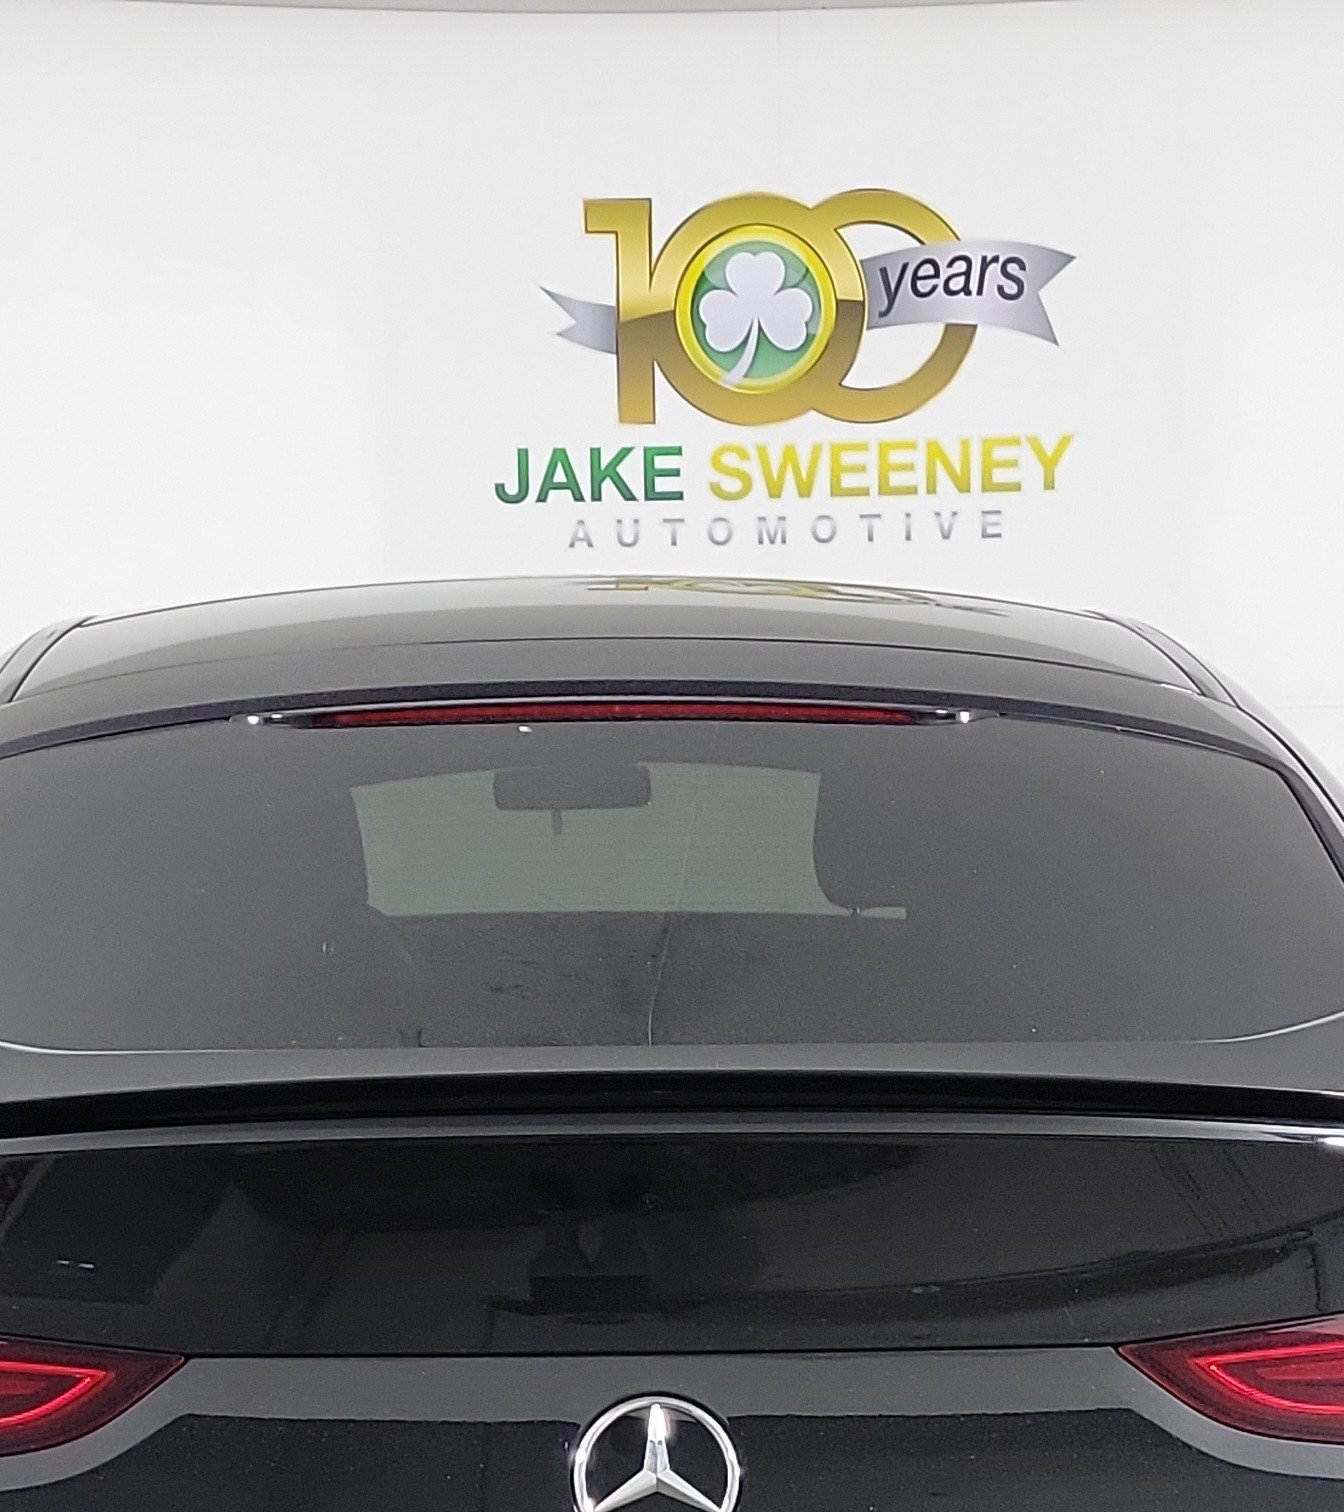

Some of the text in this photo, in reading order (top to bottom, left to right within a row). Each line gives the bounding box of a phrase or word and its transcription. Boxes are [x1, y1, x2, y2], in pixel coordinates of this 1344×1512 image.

[583, 187, 1028, 428] 100 years
[494, 434, 1074, 505] JAKE SWEENEY
[568, 510, 1004, 549] AUTOMOTIVE
